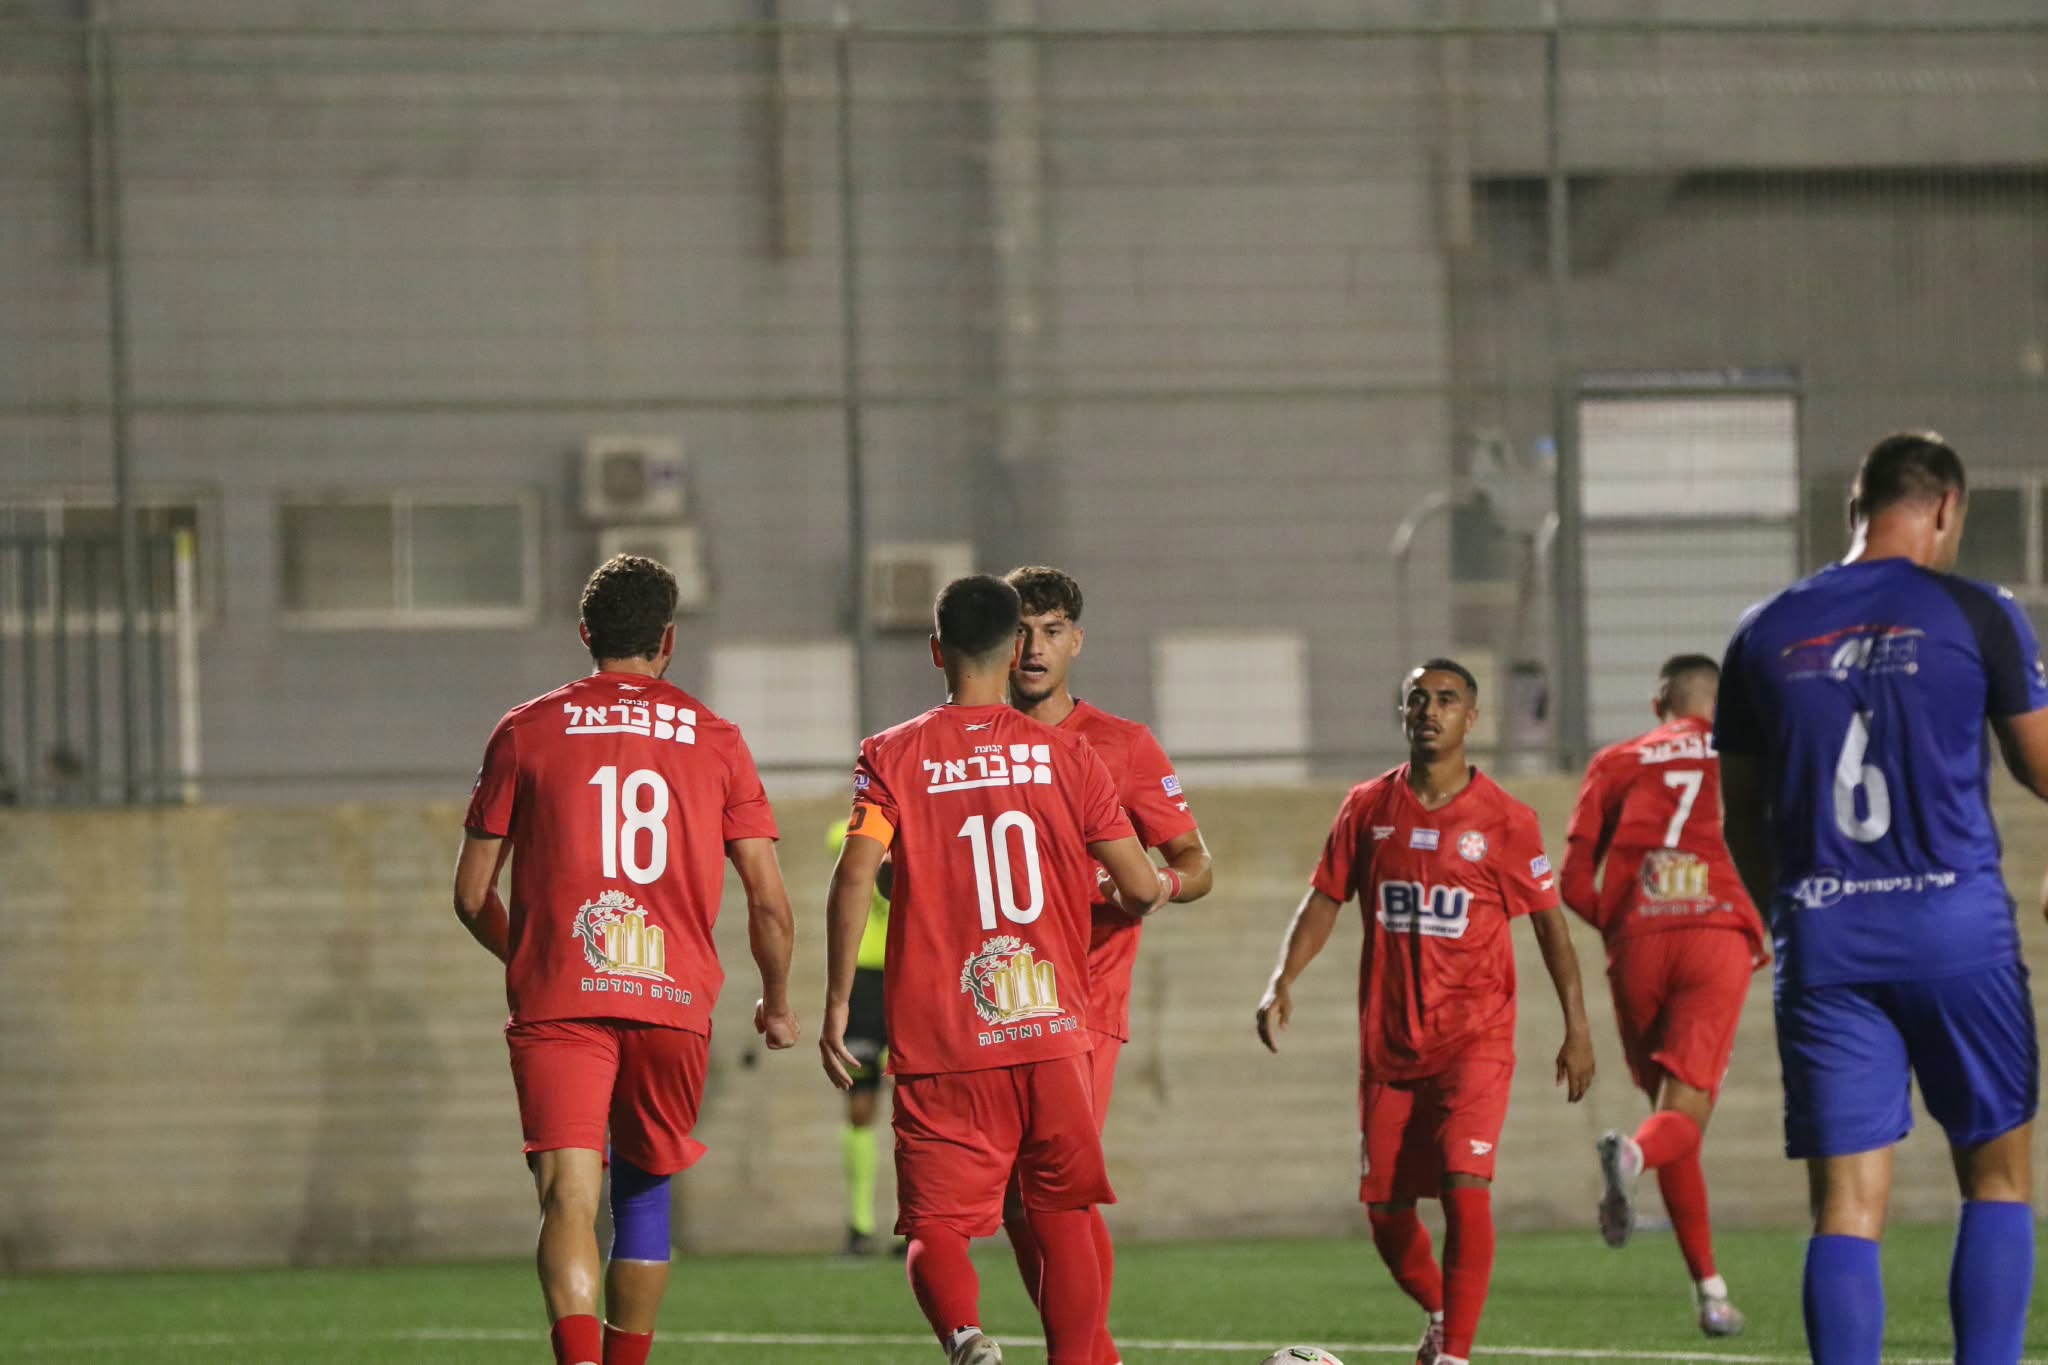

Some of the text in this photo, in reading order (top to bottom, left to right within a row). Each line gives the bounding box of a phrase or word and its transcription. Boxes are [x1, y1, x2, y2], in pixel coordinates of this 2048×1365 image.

[563, 702, 651, 728] בראל
[974, 745, 1003, 754] קבוצת
[923, 755, 1009, 784] בראל
[1833, 709, 1892, 843] 6
[1664, 769, 1704, 848] 7
[588, 765, 669, 885] 18
[957, 810, 1045, 930] 10
[1383, 884, 1465, 920] BLU
[581, 978, 692, 1004] תורה ואדמה
[979, 1024, 1042, 1046] ואדמה
